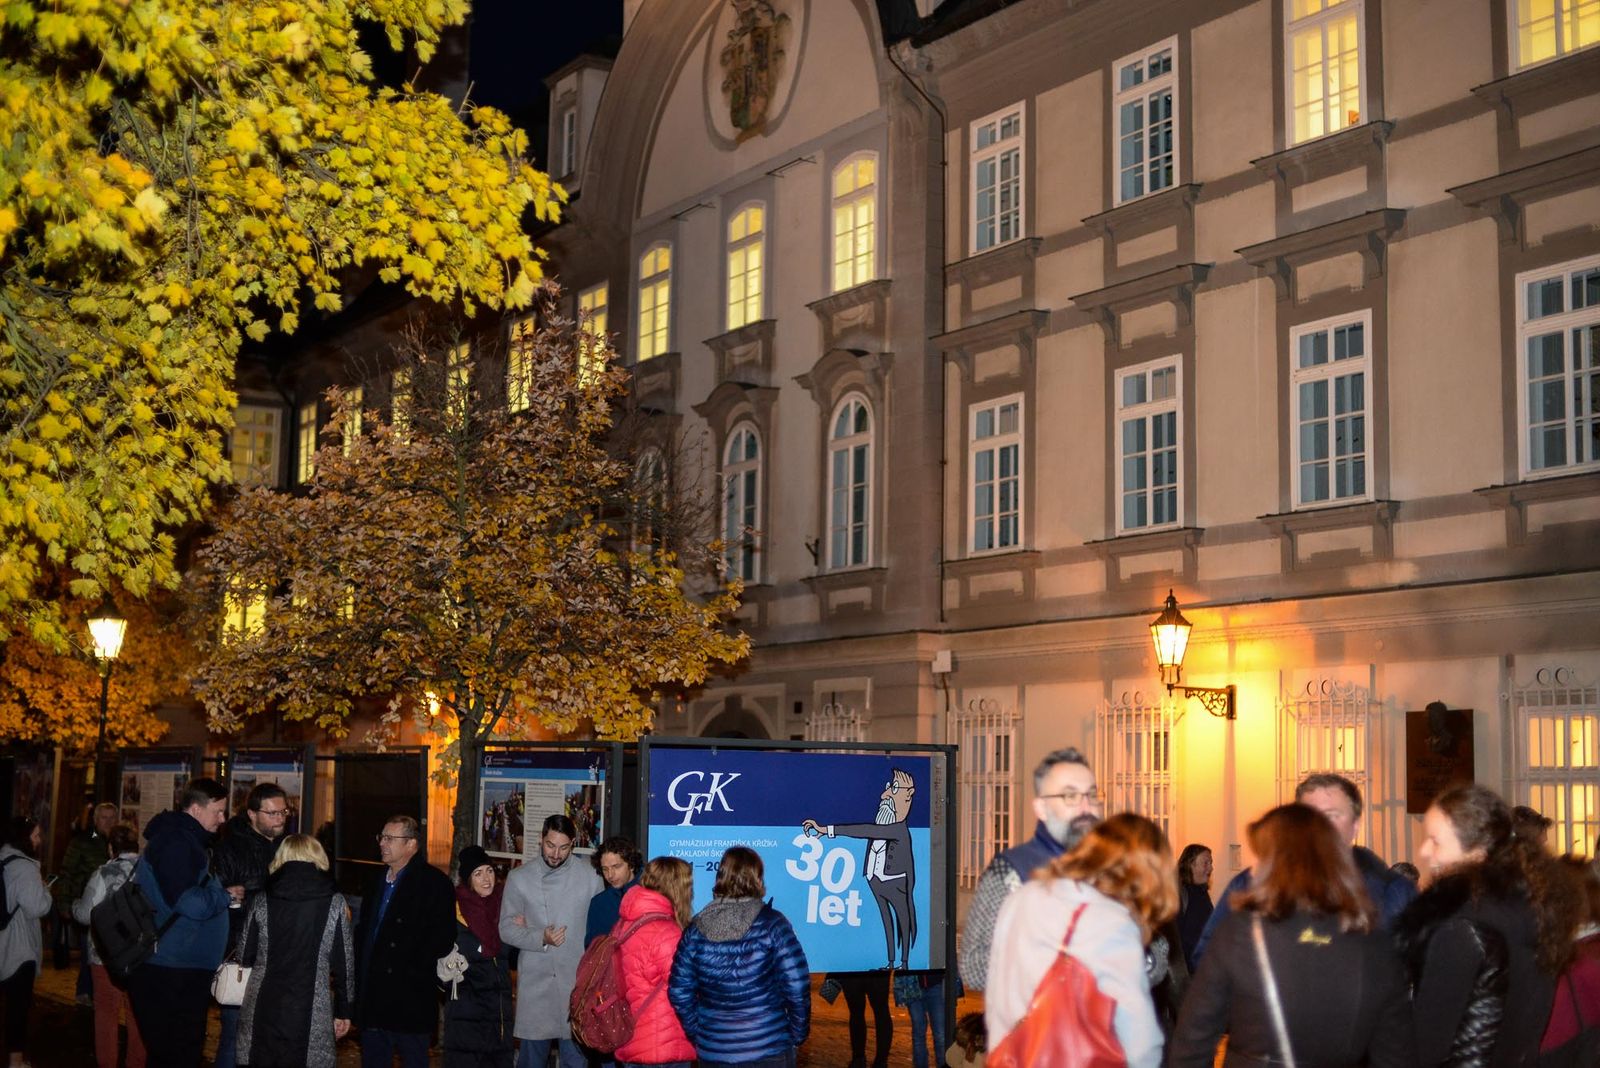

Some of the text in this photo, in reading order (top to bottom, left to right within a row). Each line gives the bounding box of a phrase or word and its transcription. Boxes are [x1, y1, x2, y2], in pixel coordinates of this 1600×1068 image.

[669, 838, 713, 847] GYMNÁZIUM
[713, 838, 751, 847] FRANTIŠKA
[669, 849, 724, 857] A ZÁKLADNÍ ŠKO
[785, 833, 856, 893] 30
[806, 884, 862, 926] let
